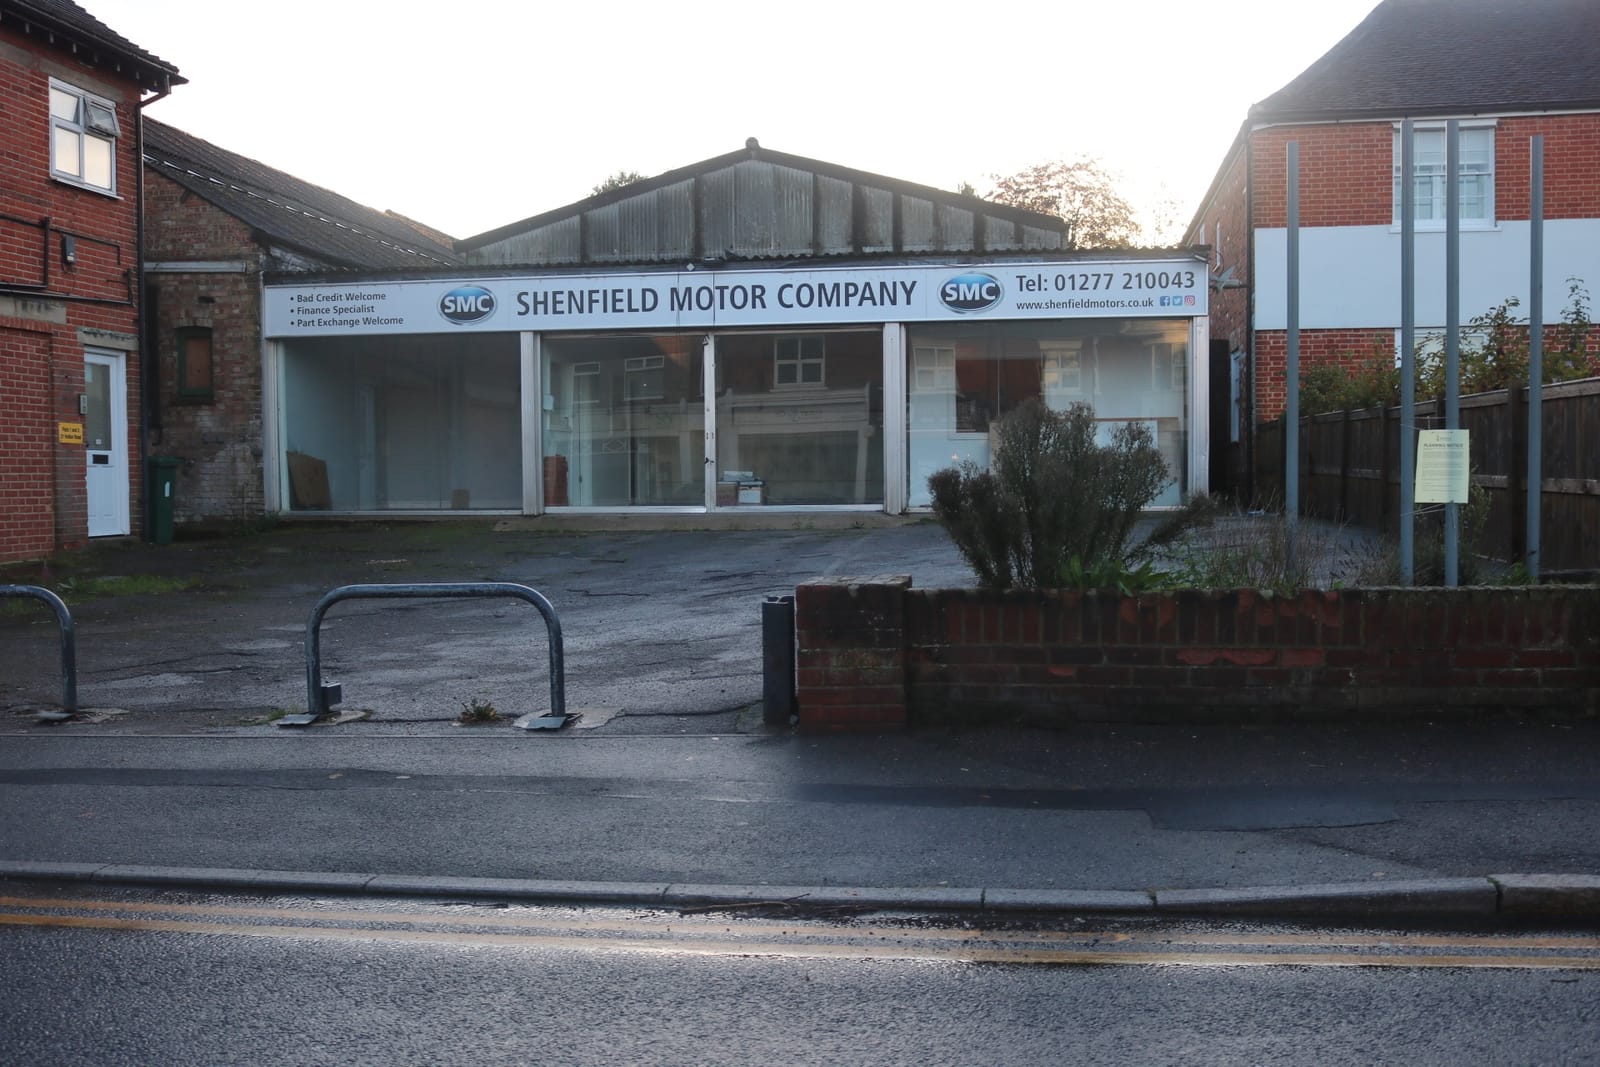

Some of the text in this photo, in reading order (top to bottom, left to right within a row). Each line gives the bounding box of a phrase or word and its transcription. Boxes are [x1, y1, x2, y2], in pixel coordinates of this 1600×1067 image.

[1016, 271, 1195, 292] Tel: 01277 210043
[297, 292, 386, 303] Bad Credit Welcome
[516, 280, 918, 316] SHENFIELD MOTOR COMPANY
[944, 281, 997, 302] SMC
[297, 305, 375, 316] Finance Specialist
[443, 294, 491, 314] SMC
[1016, 297, 1154, 310] www.shenfieldmotors.co.uk
[297, 317, 403, 328] Part Exchange Welcome
